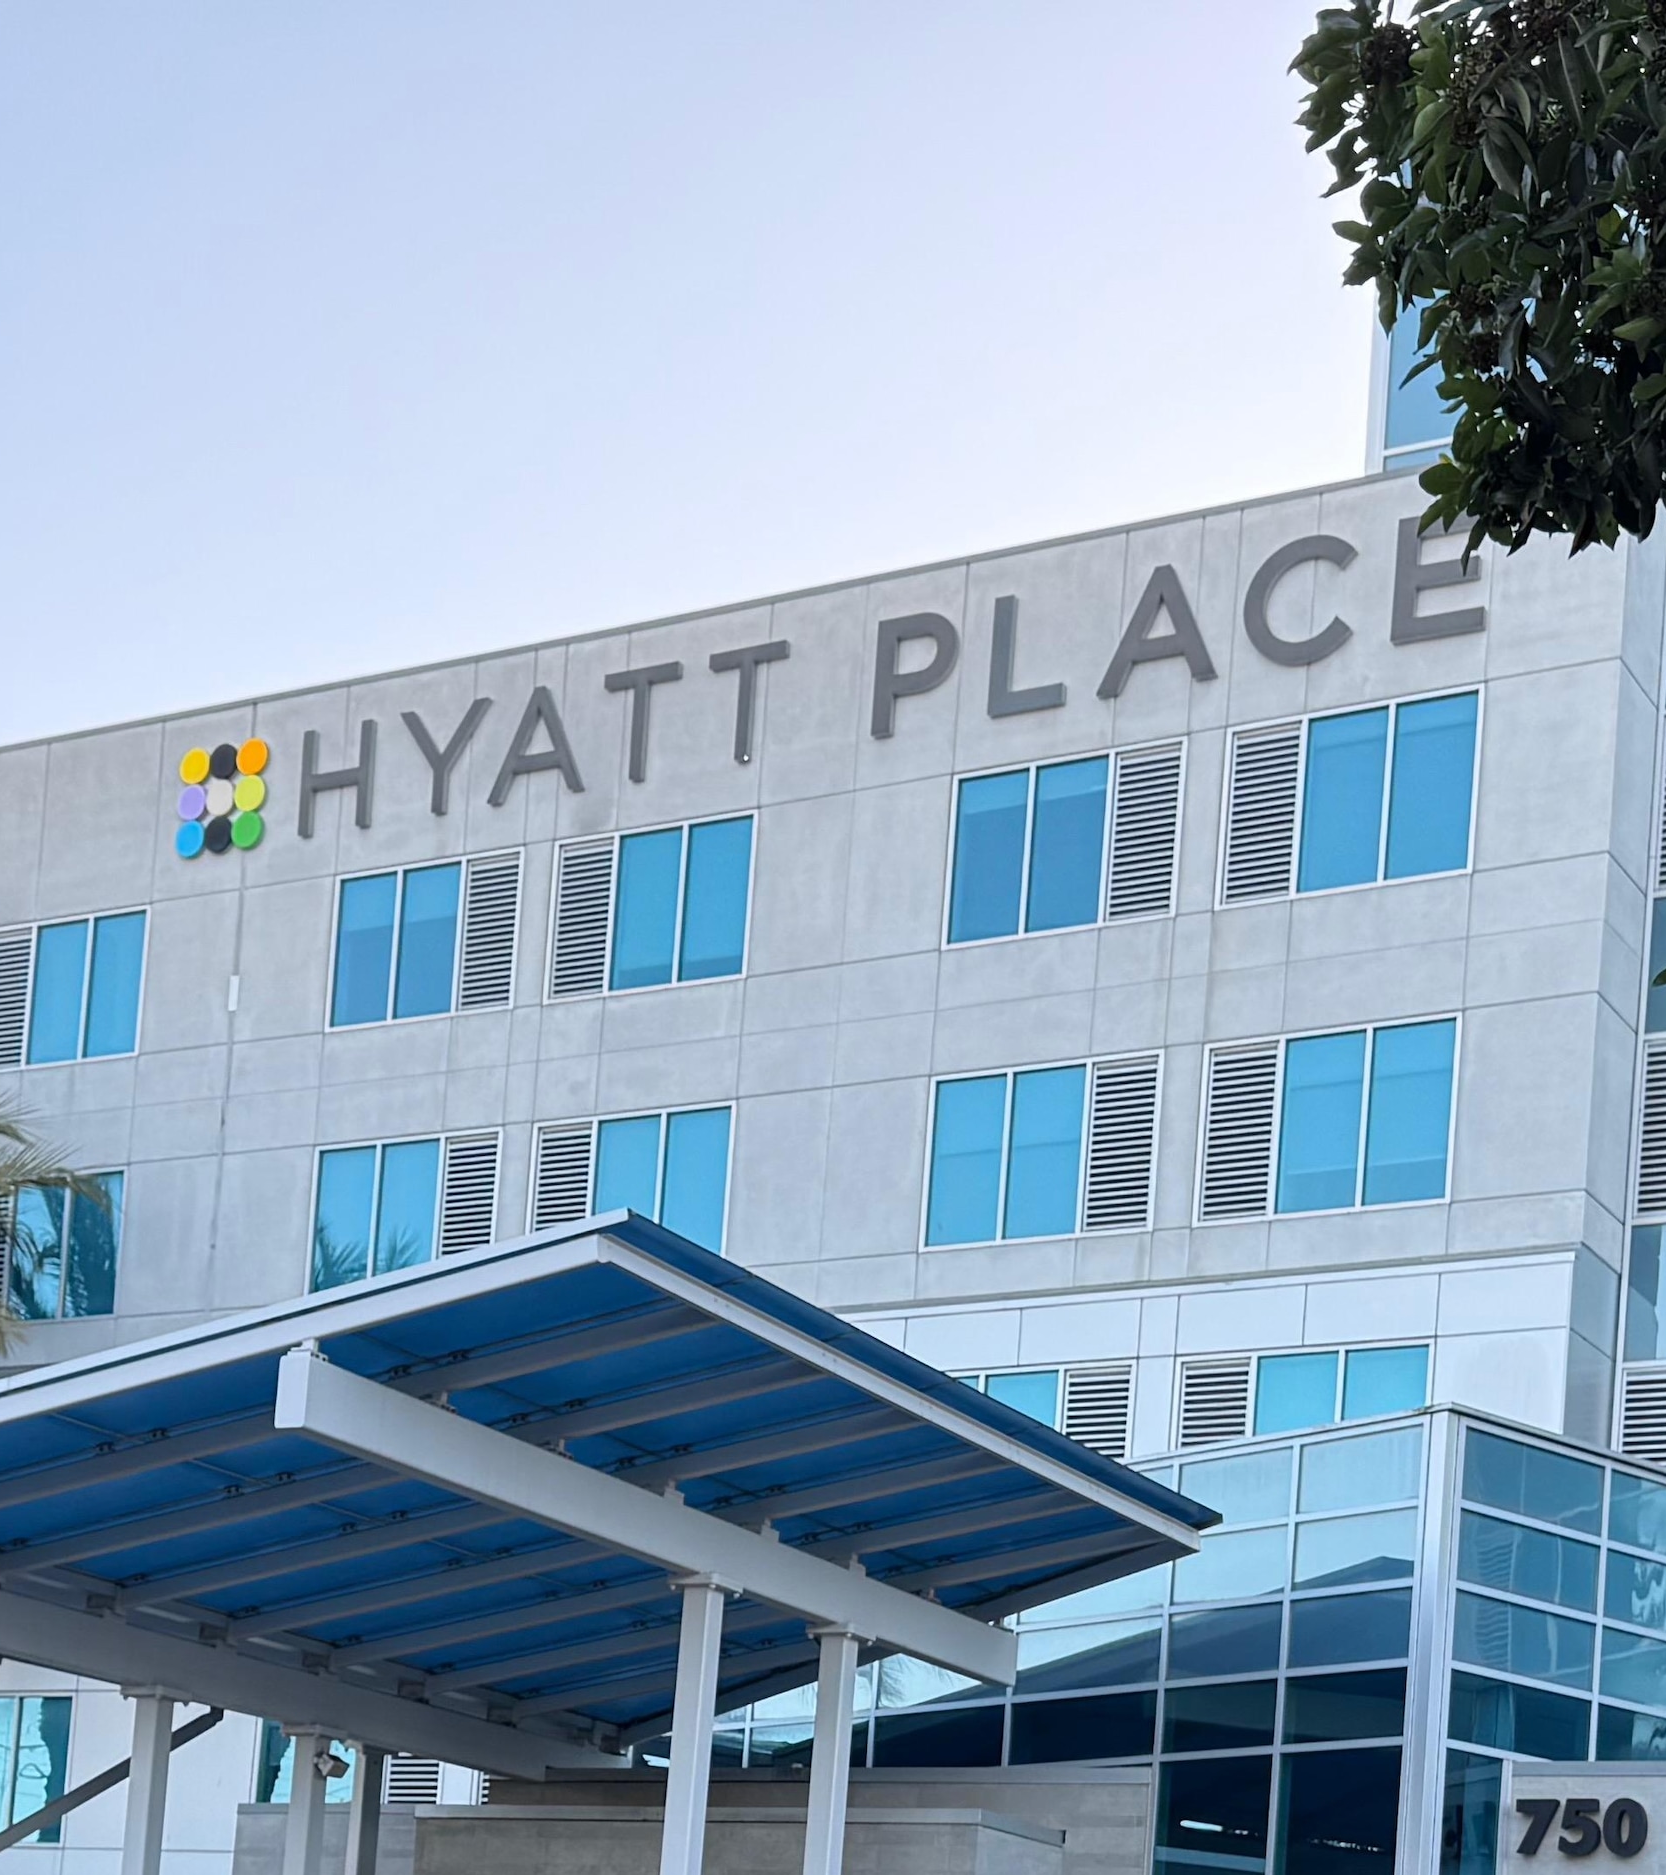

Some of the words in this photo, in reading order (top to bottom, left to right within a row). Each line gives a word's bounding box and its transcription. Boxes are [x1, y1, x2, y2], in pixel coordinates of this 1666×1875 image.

[297, 640, 791, 838] HYATT
[870, 515, 1487, 739] PLACE
[1516, 1797, 1648, 1859] 750
